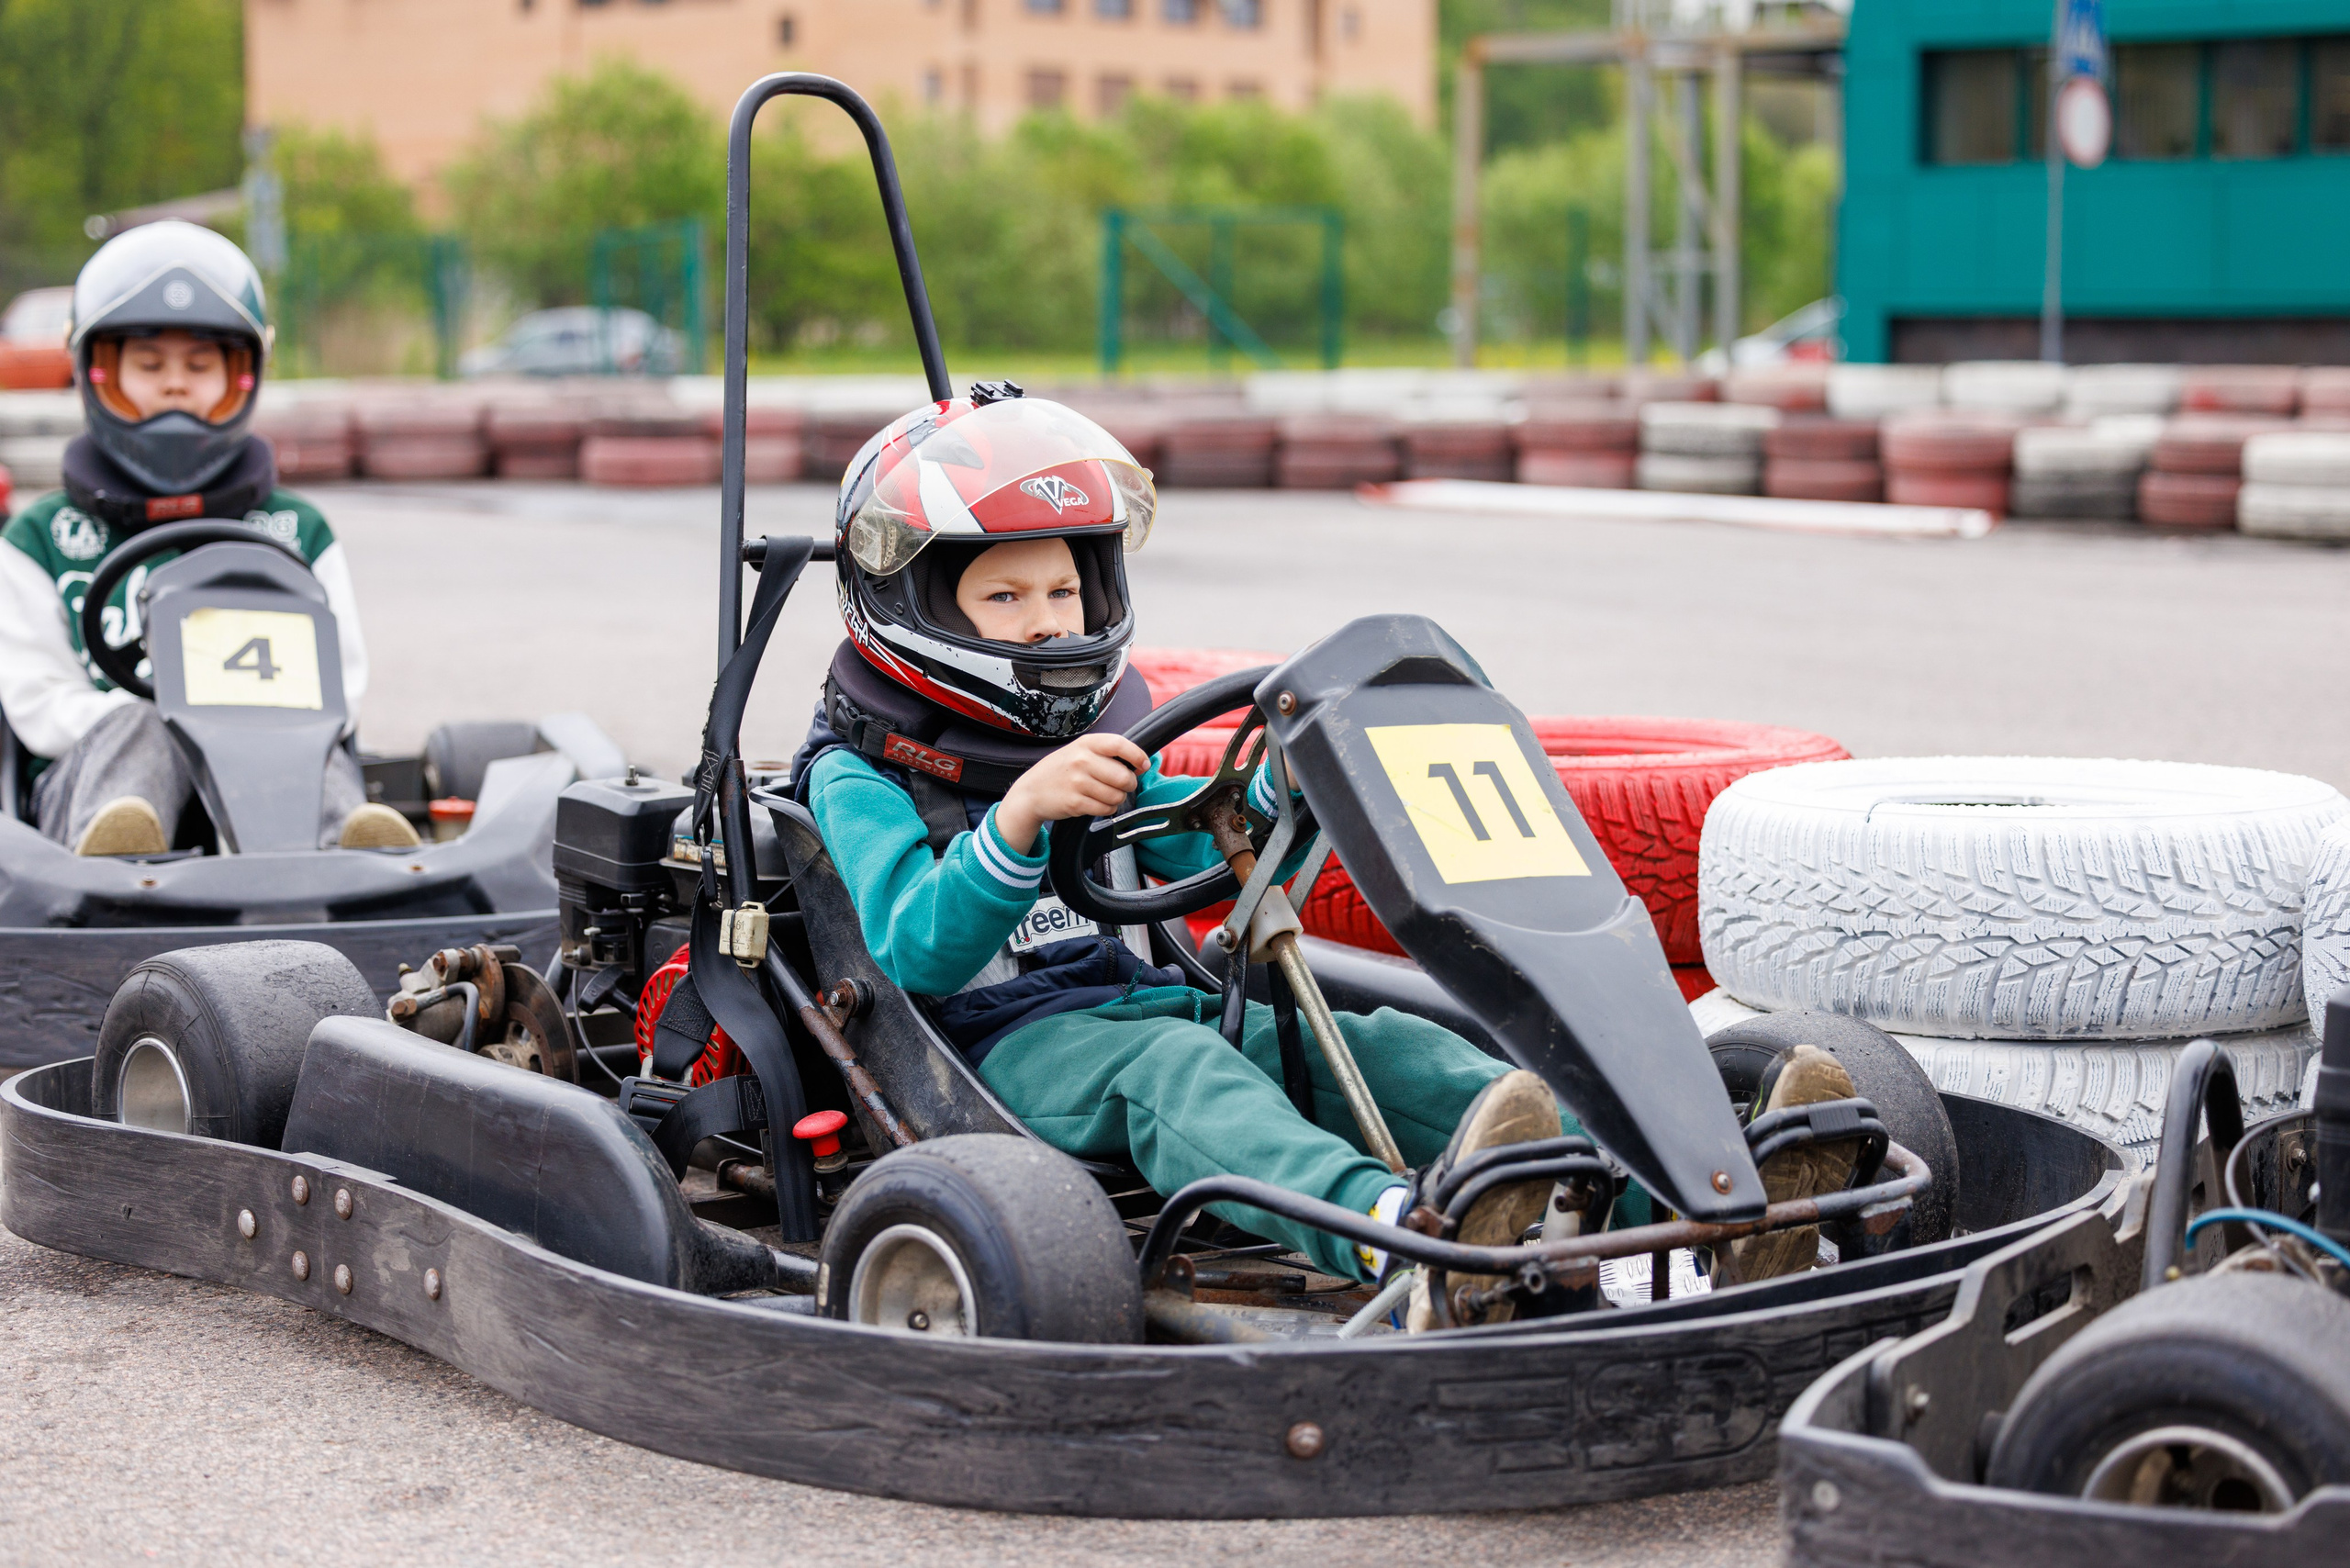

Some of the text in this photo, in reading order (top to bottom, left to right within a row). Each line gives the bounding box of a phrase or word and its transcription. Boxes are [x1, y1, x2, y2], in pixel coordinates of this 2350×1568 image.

[1056, 497, 1084, 508] VEGA
[223, 637, 282, 680] 4
[892, 741, 957, 771] RLG
[893, 752, 952, 778] RACE WEAR
[1427, 761, 1537, 841] 11
